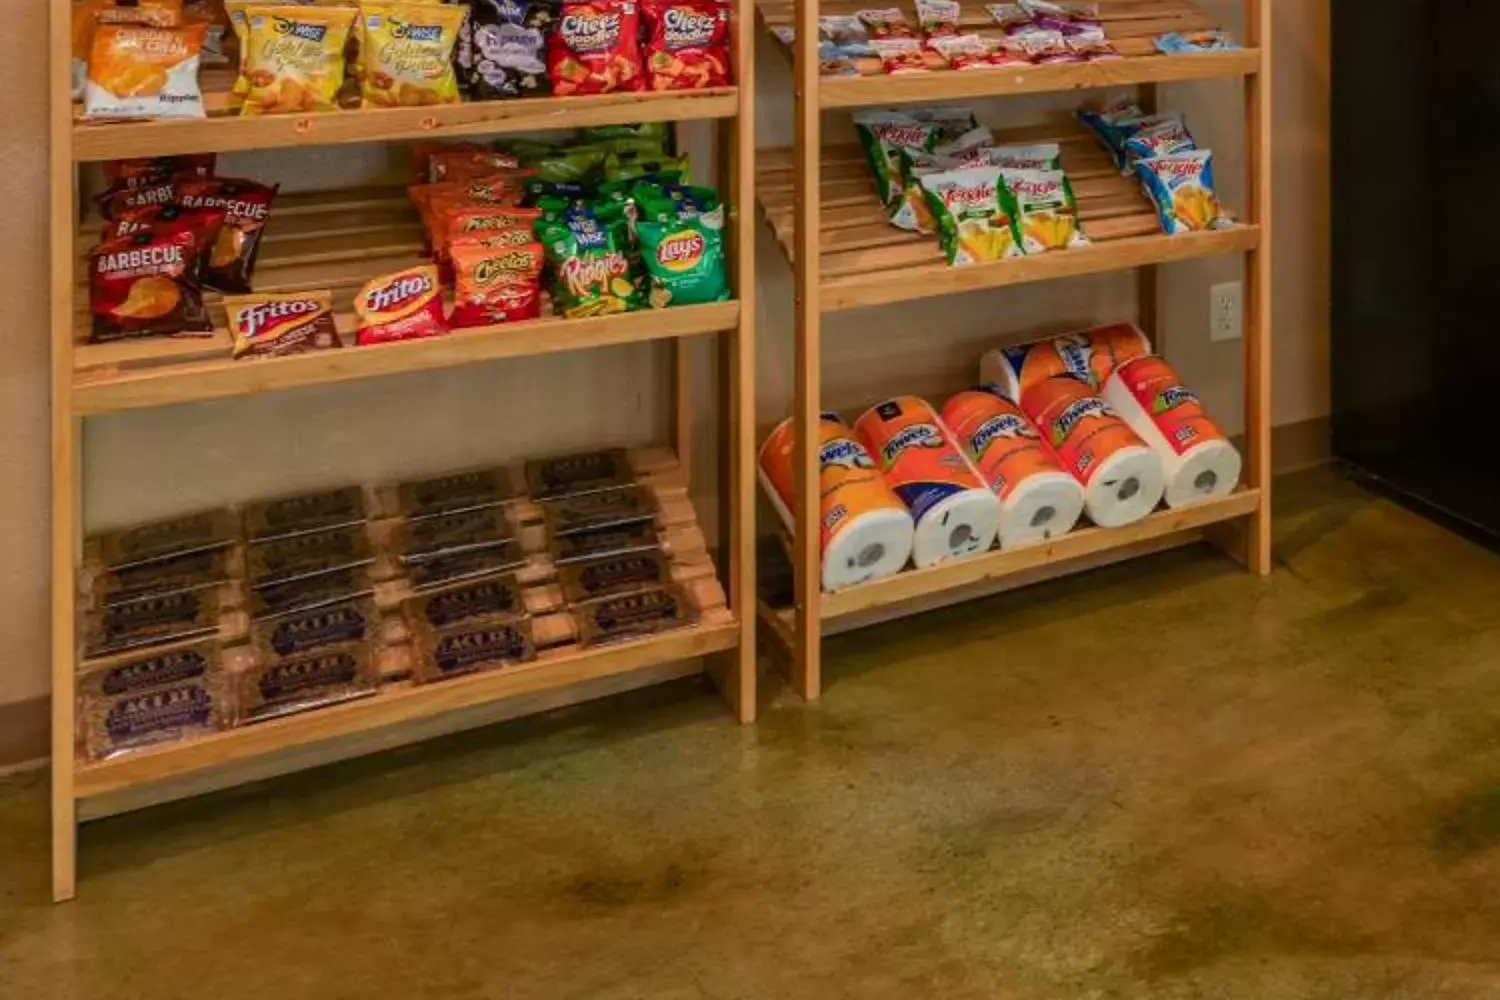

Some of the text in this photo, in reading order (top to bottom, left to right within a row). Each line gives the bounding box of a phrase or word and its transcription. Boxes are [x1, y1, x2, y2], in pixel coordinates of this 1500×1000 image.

[560, 11, 620, 37] Cheez
[663, 9, 716, 33] Cheez
[97, 245, 185, 273] BARBECUE
[365, 273, 432, 313] Fritos
[236, 299, 320, 338] Fritos
